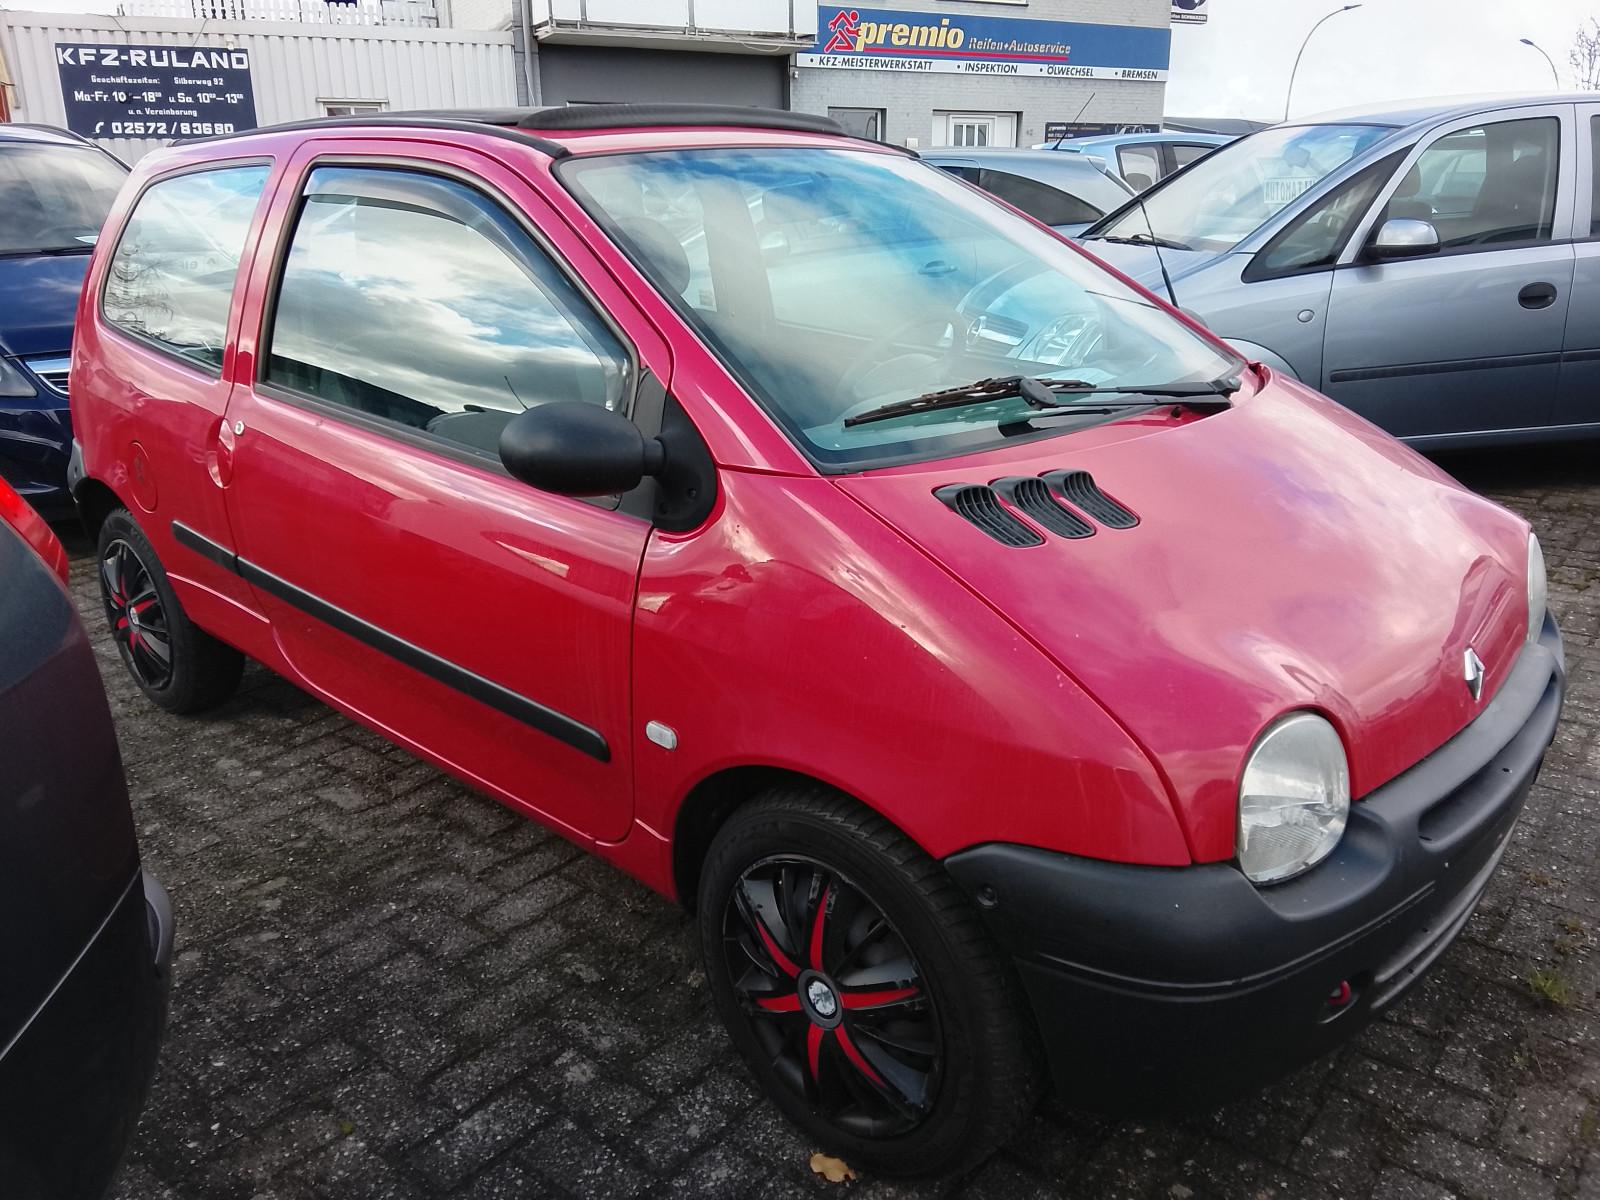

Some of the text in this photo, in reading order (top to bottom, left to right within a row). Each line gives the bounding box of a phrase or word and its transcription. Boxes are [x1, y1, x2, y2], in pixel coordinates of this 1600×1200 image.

[855, 18, 965, 52] premio
[56, 47, 249, 70] KFZ-RULAND
[818, 56, 1159, 79] KFZ-MEISTERWERKSTATT INSPEKTION ÖLWECHSEL BREMSEN
[144, 107, 198, 117] Vereinbarung
